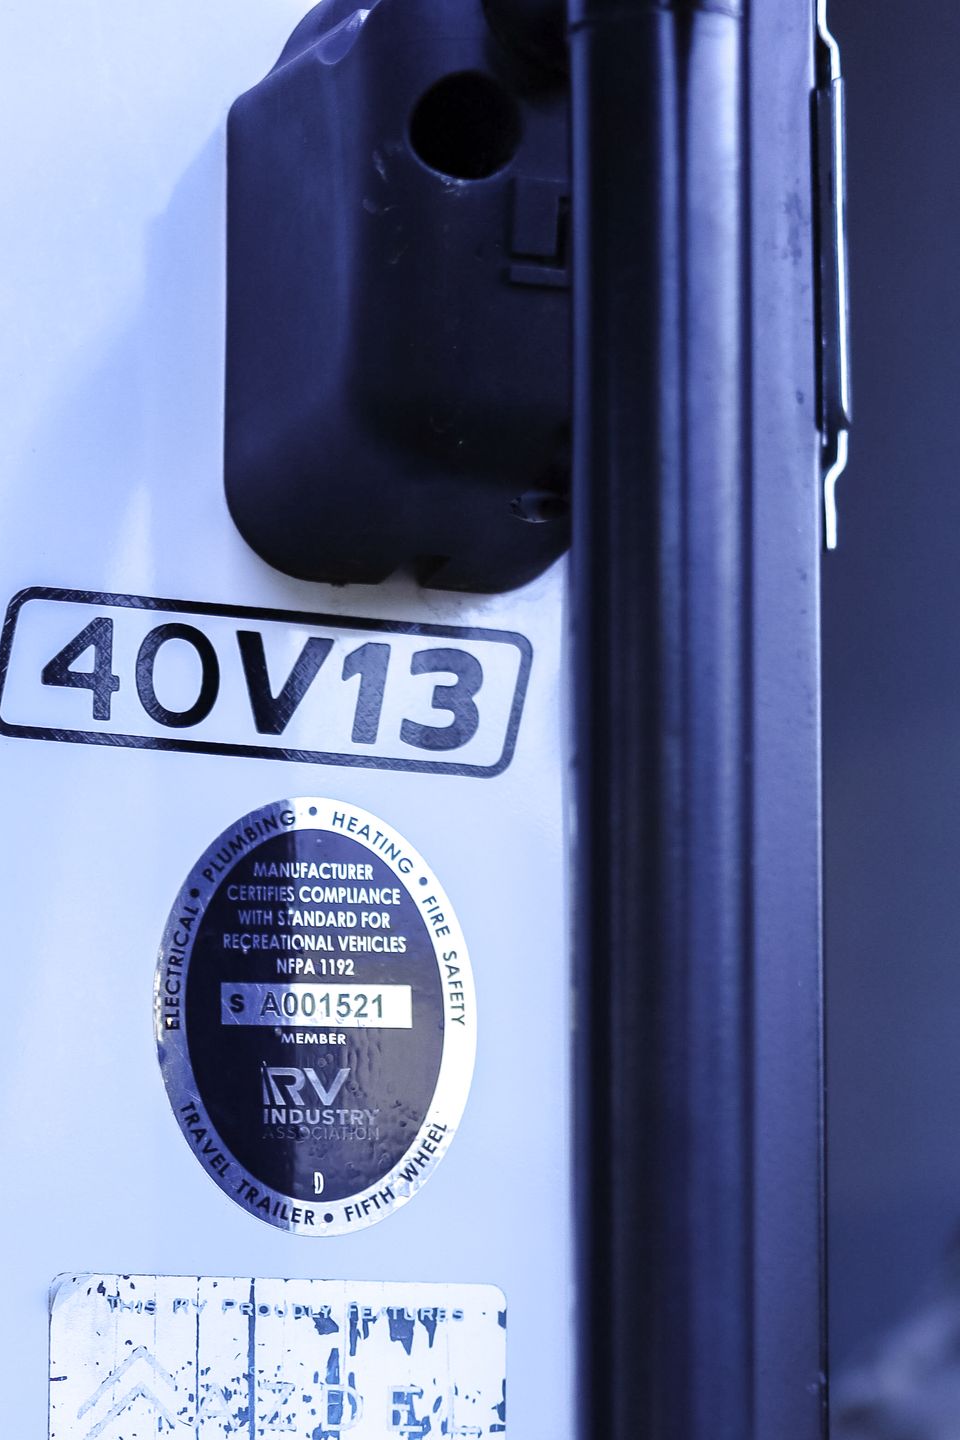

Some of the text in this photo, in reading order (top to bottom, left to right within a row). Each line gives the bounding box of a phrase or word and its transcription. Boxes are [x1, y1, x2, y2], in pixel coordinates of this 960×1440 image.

[253, 862, 374, 881] MANUFACTURER
[227, 885, 401, 906] CERTIFIES COMPLIANCE
[164, 809, 466, 1031] ELECTRICAL PLUMBING HEATING FIRE SAFETY
[238, 909, 391, 929] WITH STANDARD FOR
[223, 933, 407, 953] RECREATIONAL VEHICLES
[276, 958, 355, 976] NFPA 1192
[229, 992, 383, 1019] S A001521
[280, 1033, 347, 1045] MEMBER
[262, 1067, 351, 1106] RV
[263, 1108, 380, 1125] INDUSTRY
[262, 1126, 380, 1141] ASSOCIATION
[180, 1104, 448, 1226] TRAVEL TRAILER FIFTH WHEEL
[313, 1171, 325, 1194] D
[222, 1299, 332, 1319] PROUDLY
